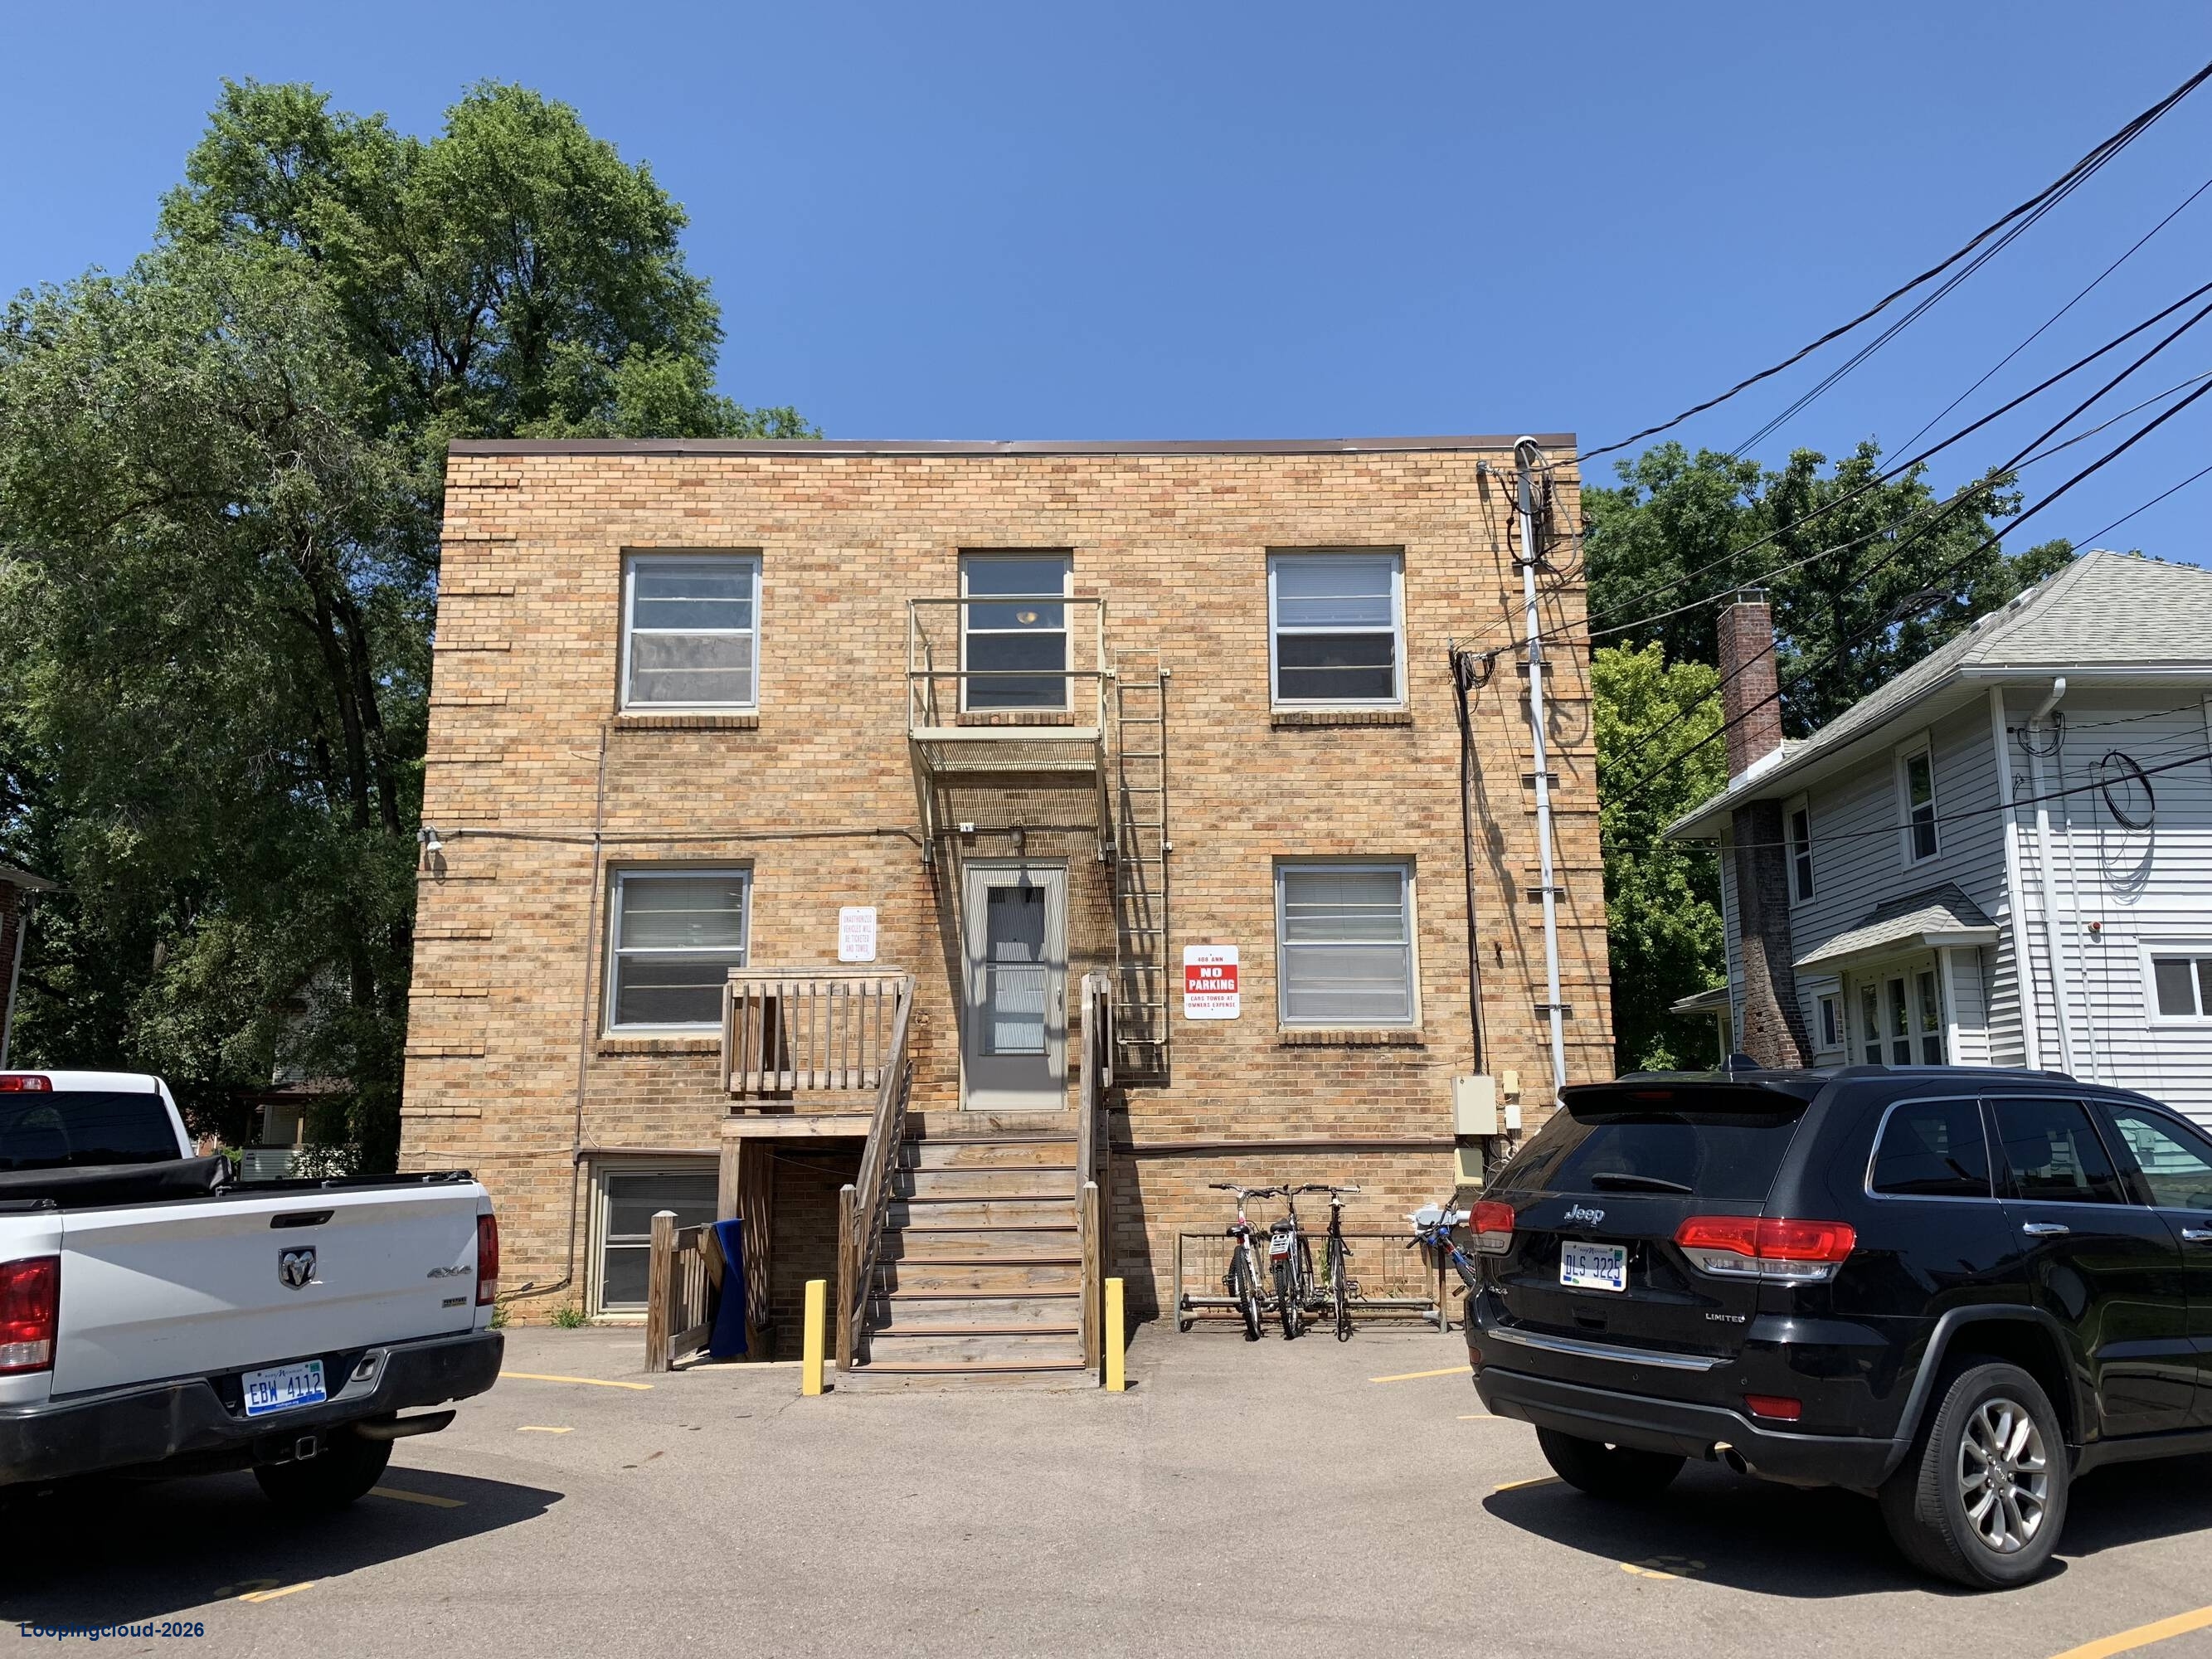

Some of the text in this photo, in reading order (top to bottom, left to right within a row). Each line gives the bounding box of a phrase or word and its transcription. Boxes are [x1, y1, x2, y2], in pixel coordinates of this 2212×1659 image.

[1200, 967, 1223, 978] NO
[1189, 979, 1235, 990] PARKING
[1564, 1204, 1605, 1228] Jeep
[1566, 1254, 1621, 1279] DLS 3225
[1705, 1313, 1745, 1323] LIMITED
[250, 1373, 322, 1405] EBW 4112
